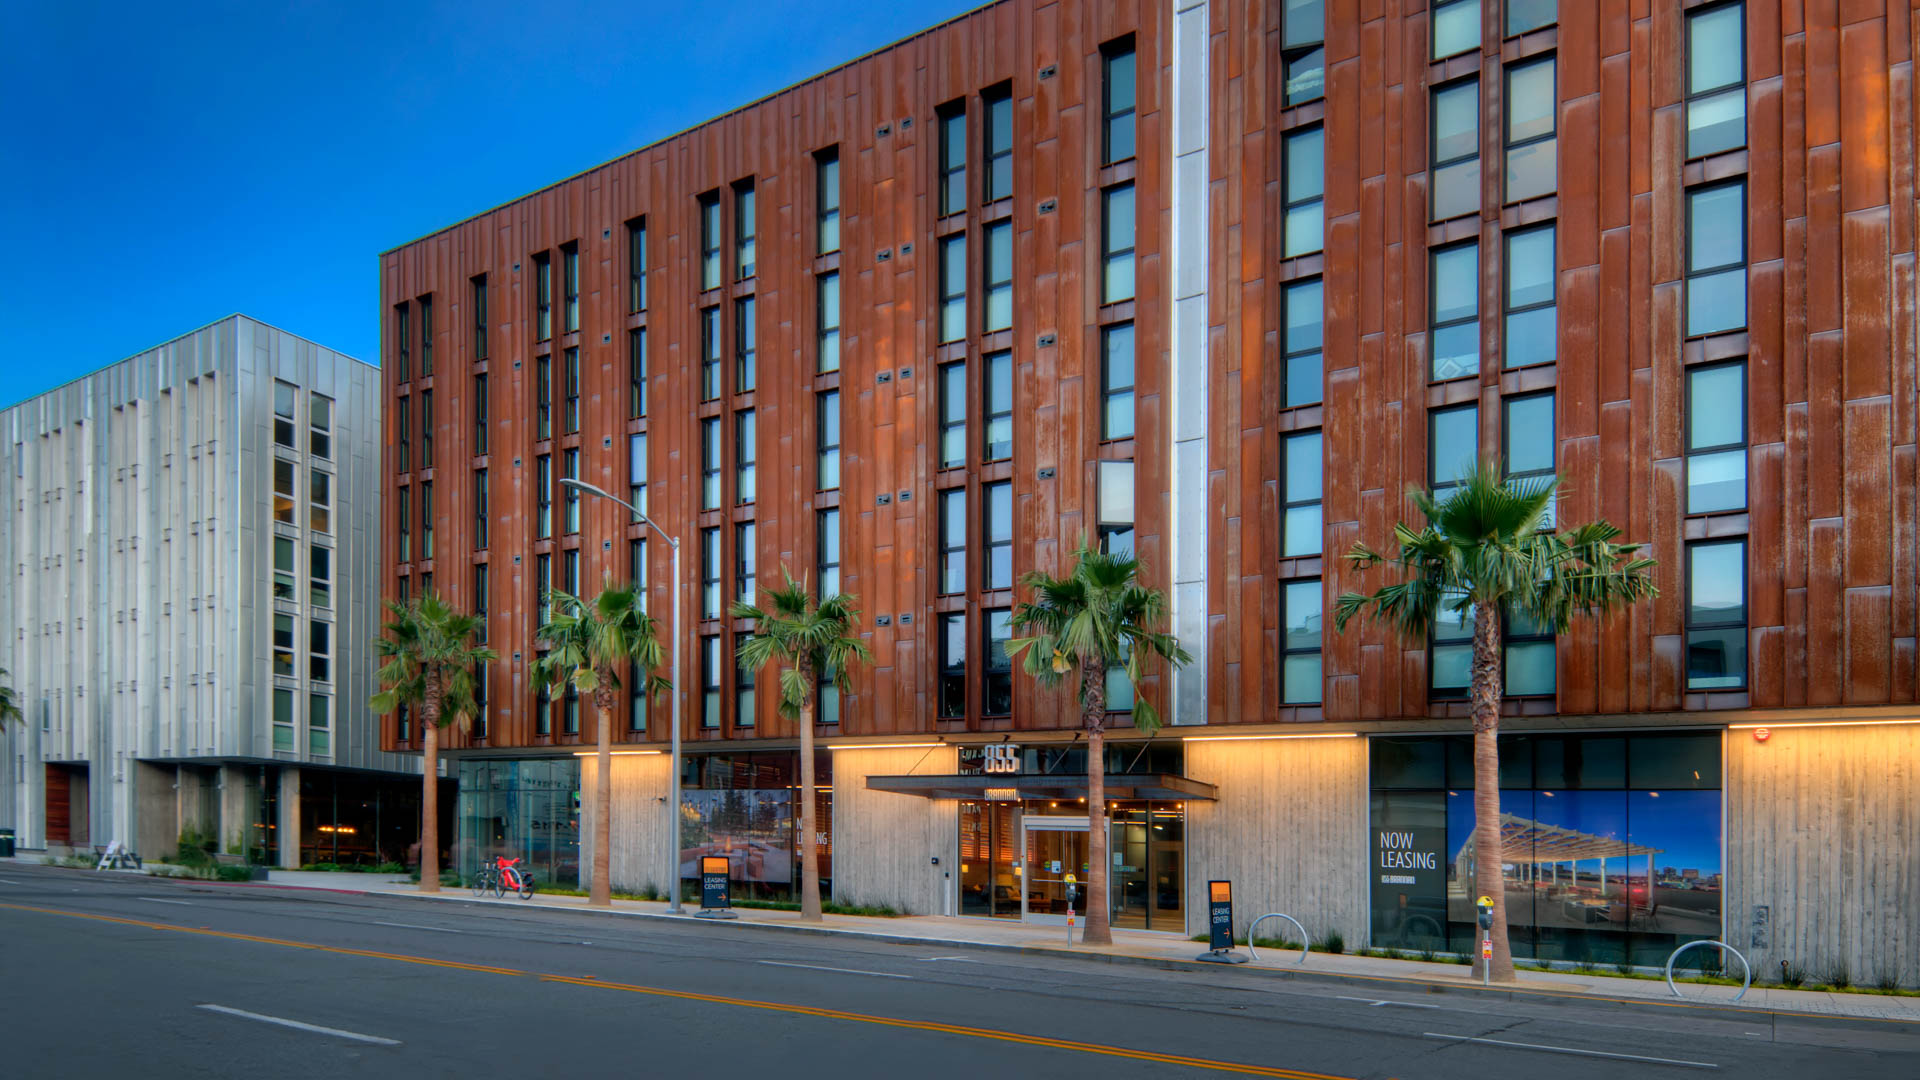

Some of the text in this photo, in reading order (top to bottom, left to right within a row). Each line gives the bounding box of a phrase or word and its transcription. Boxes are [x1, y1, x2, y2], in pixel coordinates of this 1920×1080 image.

[984, 744, 1018, 773] 855
[1380, 831, 1414, 849] NOW
[1380, 851, 1437, 870] LEASING
[1212, 907, 1230, 916] LEASING
[1212, 915, 1230, 924] CENTER
